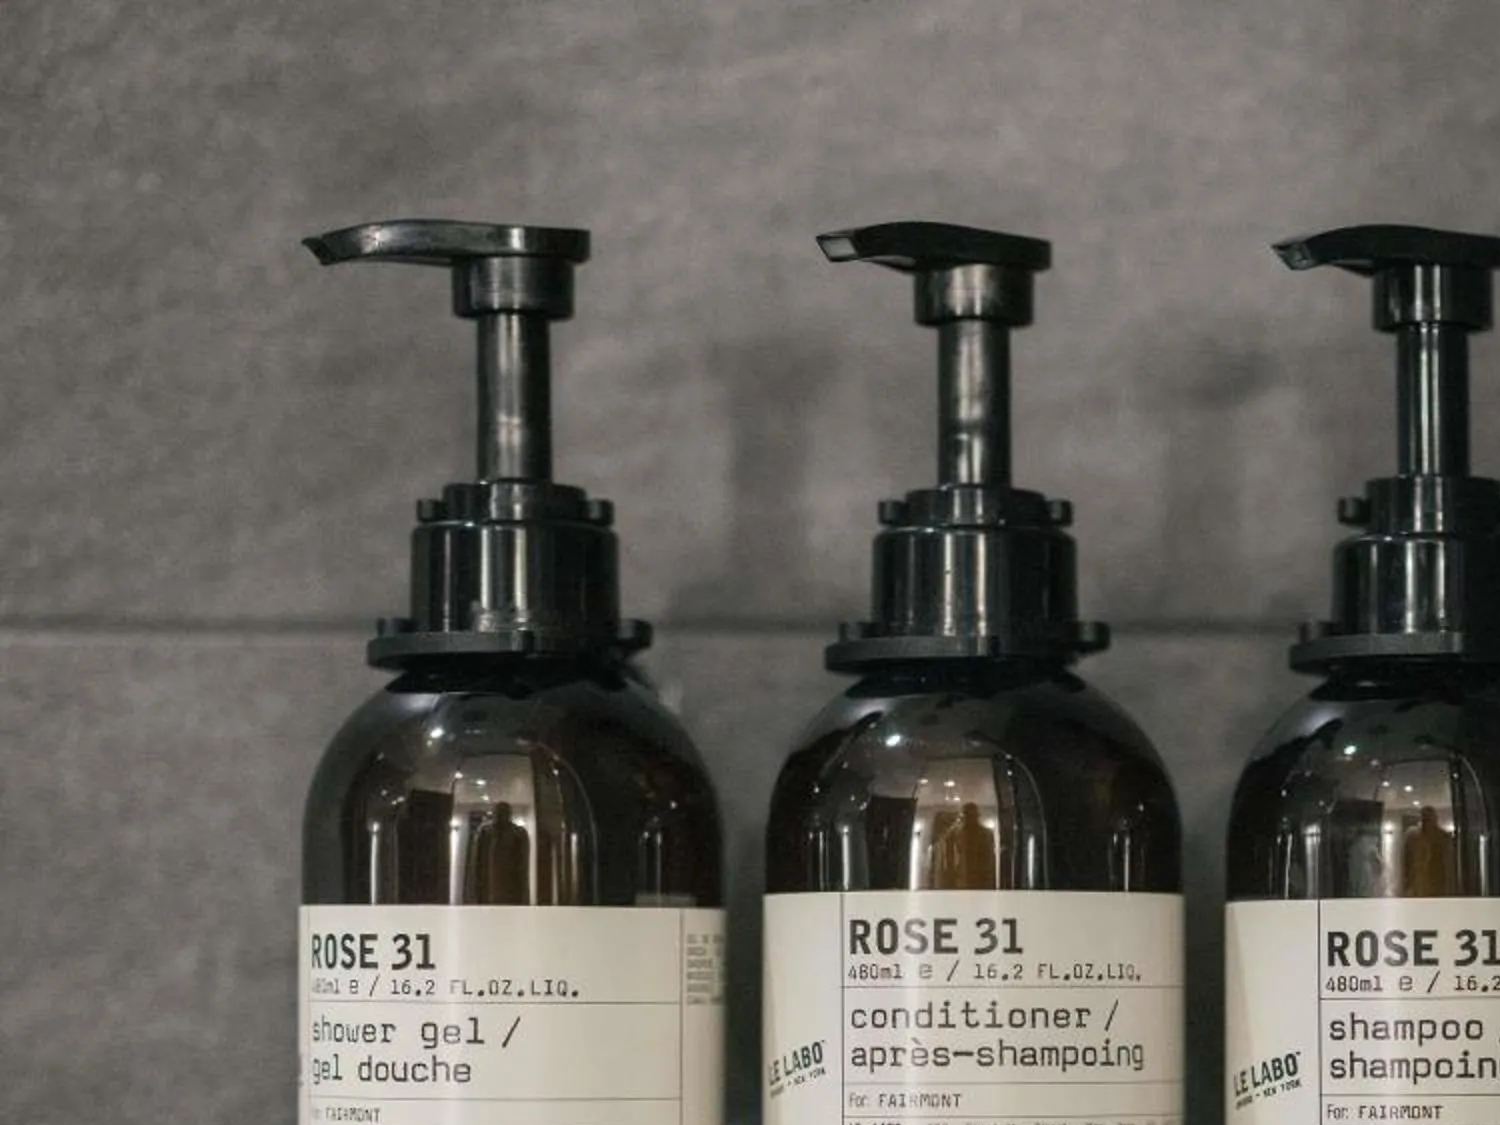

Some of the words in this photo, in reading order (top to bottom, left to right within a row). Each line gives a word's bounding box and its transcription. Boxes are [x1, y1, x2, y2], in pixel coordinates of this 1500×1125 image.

[312, 933, 378, 970] ROSE
[390, 933, 436, 970] 31
[849, 918, 959, 956] ROSE
[974, 918, 1024, 956] 31
[1327, 929, 1440, 967] ROSE
[390, 979, 436, 997] 16.2
[449, 979, 580, 997] FL.OZ.LIQ.
[848, 964, 903, 980] 480ml
[974, 964, 1024, 982] 16.2
[1326, 974, 1383, 993] 480ml
[312, 1015, 396, 1044] shower
[421, 1017, 486, 1049] gel
[850, 1000, 1092, 1030] conditioner
[1329, 1011, 1484, 1046] shampoo
[312, 1054, 343, 1084] gel
[358, 1055, 472, 1083] douche
[783, 1040, 823, 1077] LABO
[850, 1037, 1144, 1072] après-shampoing
[1250, 1053, 1299, 1088] LABO
[879, 1093, 962, 1109] FAIRMONT
[1358, 1104, 1444, 1120] FAIRMONT
